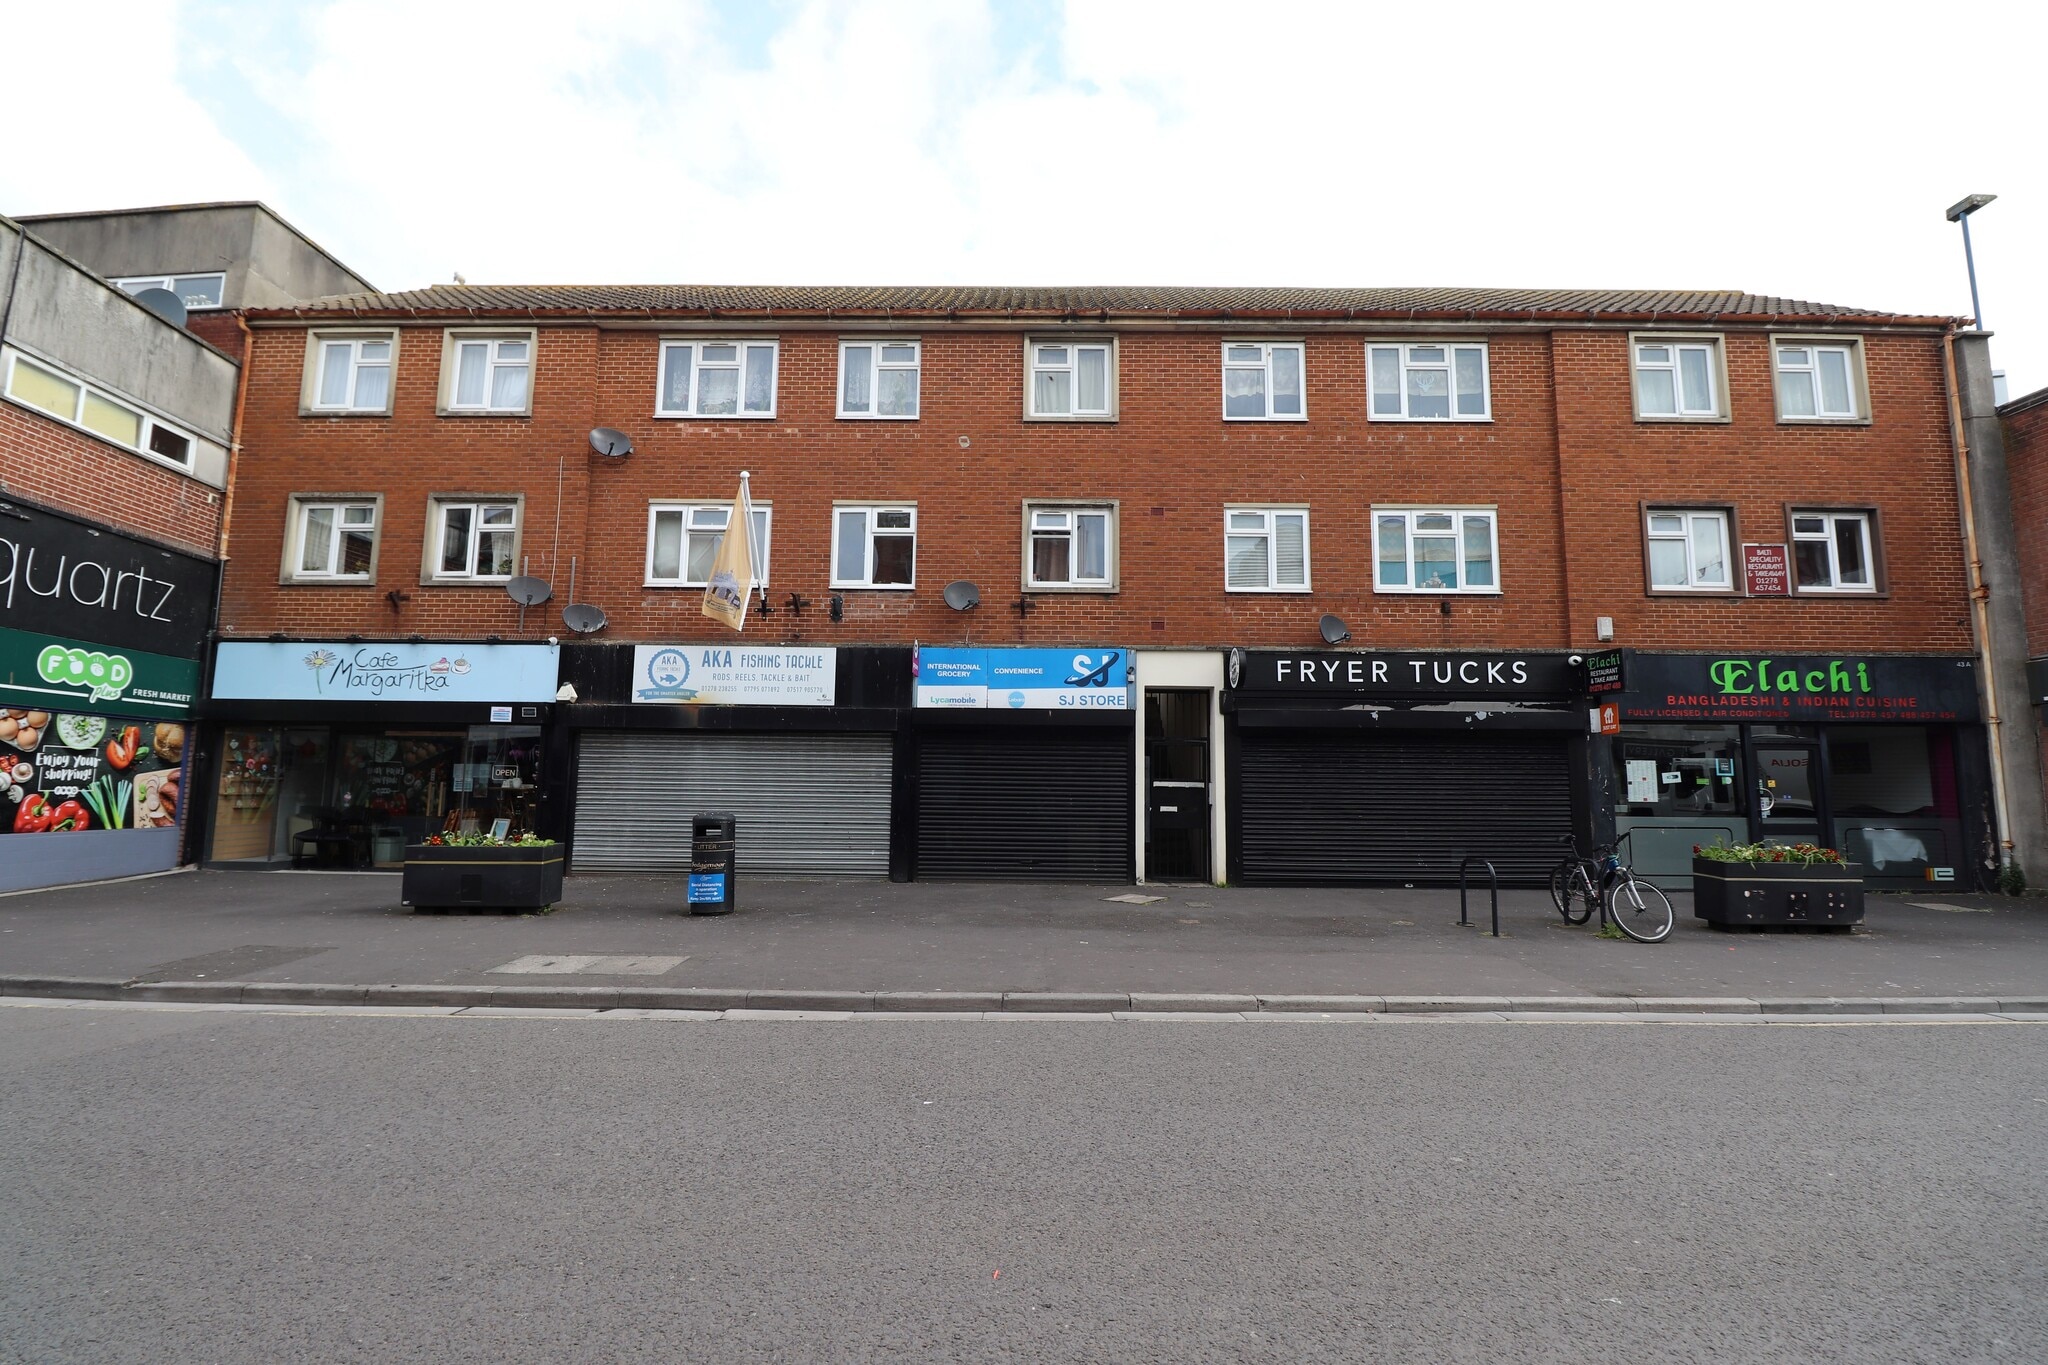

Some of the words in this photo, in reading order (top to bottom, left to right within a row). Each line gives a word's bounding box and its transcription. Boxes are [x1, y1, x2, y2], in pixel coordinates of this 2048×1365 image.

[0, 537, 175, 623] quartz
[354, 648, 399, 668] Cafe
[661, 655, 678, 665] AKA
[701, 650, 733, 668] AKA
[740, 654, 781, 669] FISHING
[785, 655, 823, 669] TACKLE
[1586, 653, 1621, 670] Elachi
[927, 663, 981, 671] INTERNATIONAL
[1067, 653, 1116, 687] SJ
[1276, 660, 1389, 683] FRYER
[1408, 661, 1528, 684] TUCKS
[1590, 667, 1618, 677] RESTAURANT
[328, 658, 450, 696] Margaritka
[761, 674, 785, 682] TACKLE
[794, 674, 810, 682] BAIT
[1594, 676, 1606, 684] TAKE
[1605, 675, 1619, 683] AWAY
[1710, 660, 1872, 694] Elachi
[91, 684, 121, 702] plus
[132, 688, 159, 698] FRESH
[159, 690, 192, 702] MARKET
[930, 696, 977, 704] Lycamobile
[1058, 695, 1075, 706] SJ
[1079, 695, 1125, 706] STORE
[1667, 695, 1775, 706] BANGLADESHI
[1782, 697, 1790, 706] &
[1797, 697, 1849, 707] INDIAN
[1855, 697, 1918, 708] CUISINE
[1627, 709, 1654, 717] FULLY
[1729, 710, 1790, 718] CONDITIONED
[1829, 710, 1877, 719] TEL:01278
[1880, 711, 1897, 719] 457
[36, 753, 70, 768] Enjoy
[44, 768, 92, 781] shopping!
[495, 769, 516, 777] OPEN
